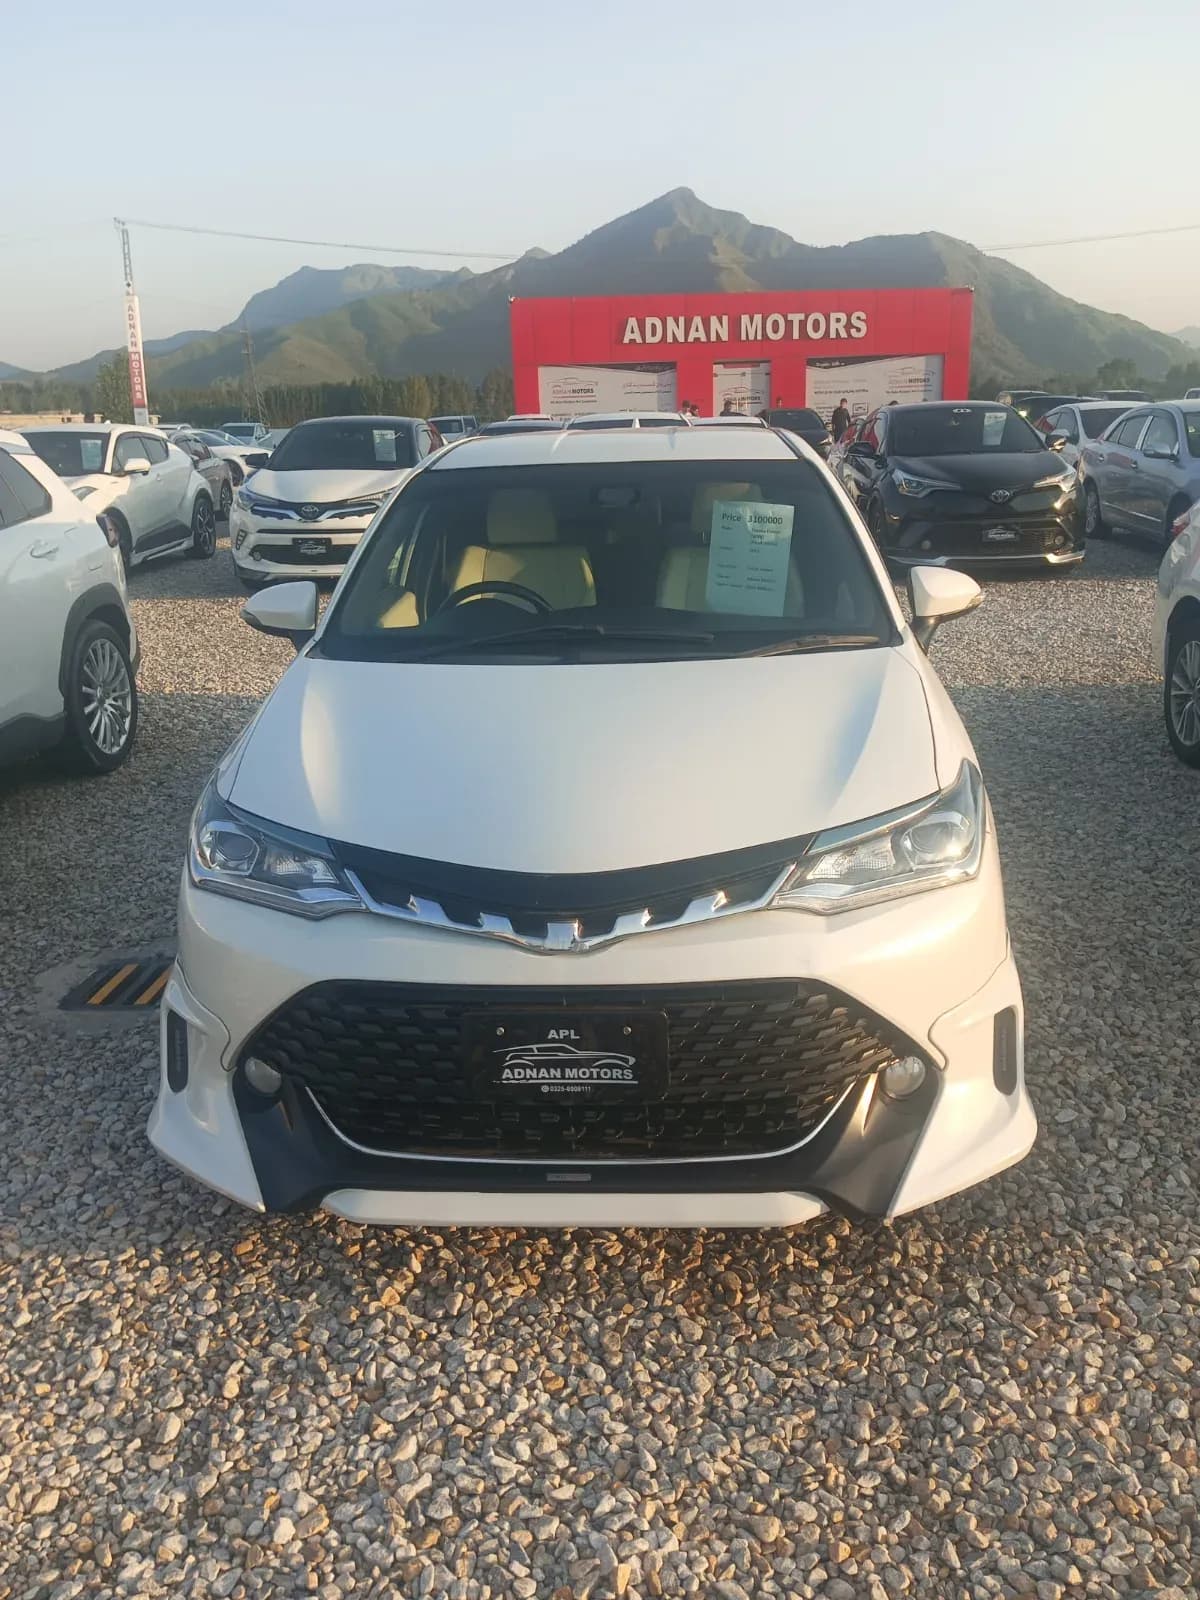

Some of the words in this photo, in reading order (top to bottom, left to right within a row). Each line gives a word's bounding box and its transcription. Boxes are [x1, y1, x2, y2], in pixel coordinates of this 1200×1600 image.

[127, 304, 137, 348] ADNAN
[623, 314, 729, 345] ADNAN
[740, 311, 867, 342] MOTORS
[131, 353, 142, 400] MOTORS
[721, 512, 742, 522] Price
[747, 515, 784, 525] 3100000
[547, 1029, 580, 1039] APL
[502, 1068, 561, 1079] ADNAN
[565, 1068, 633, 1079] MOTORS
